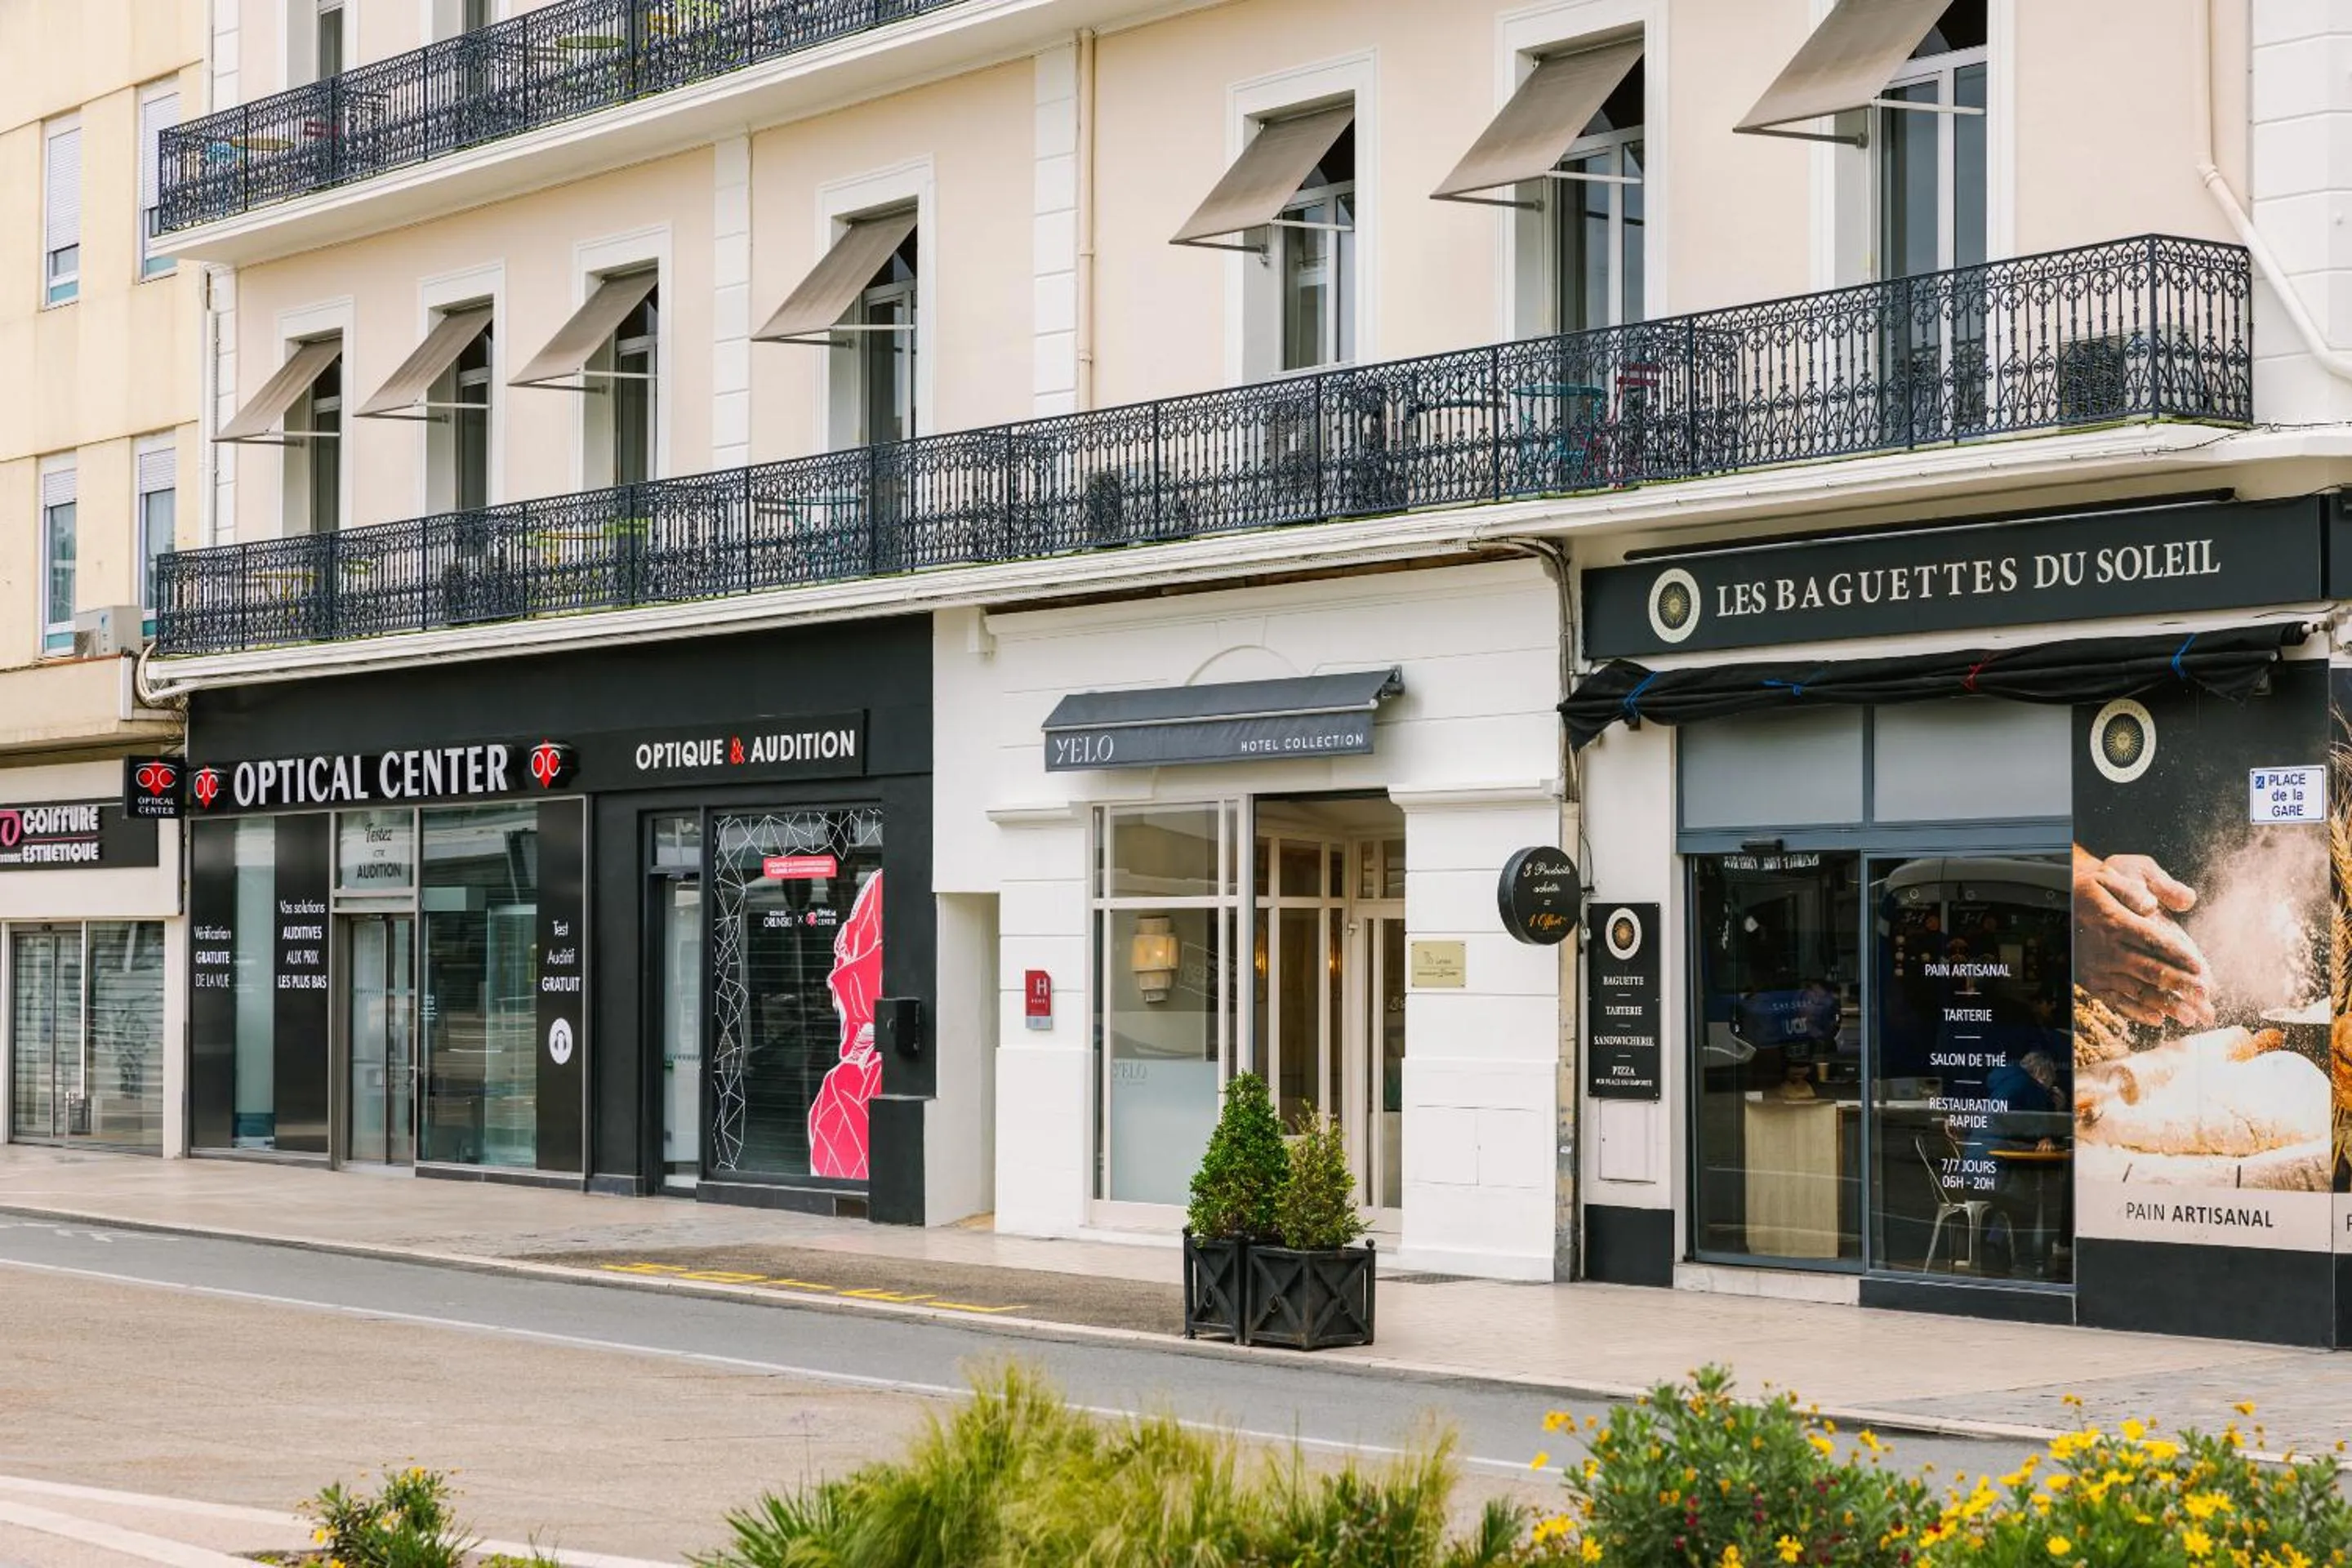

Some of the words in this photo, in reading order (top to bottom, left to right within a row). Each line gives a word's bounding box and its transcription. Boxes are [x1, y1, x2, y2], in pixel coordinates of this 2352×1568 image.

[1717, 581, 1766, 617] LES
[1775, 558, 2018, 611] BAGUETTES
[2034, 551, 2087, 589] DU
[2096, 539, 2221, 584] SOLEIL
[635, 739, 724, 770] OPTIQUE
[729, 735, 746, 764] &
[750, 730, 855, 763] AUDITION
[1055, 734, 1114, 764] YELO
[1241, 738, 1279, 752] HOTEL
[1285, 733, 1364, 751] COLLECTION
[234, 755, 370, 807] OPTICAL
[379, 744, 509, 800] CENTER
[2269, 773, 2305, 786] PLACE
[137, 796, 175, 805] OPTICAL
[2271, 789, 2287, 801] de
[2293, 788, 2303, 801] la
[138, 806, 175, 814] CENTER
[2271, 804, 2304, 817] GARE
[23, 805, 99, 835] COIFFURE
[23, 843, 99, 862] ESTHETIQUE
[357, 862, 402, 879] AUDITION
[280, 900, 292, 913] Vos
[294, 899, 325, 913] solutions
[283, 926, 322, 939] AUDITIVES
[553, 920, 568, 936] Test
[195, 951, 230, 964] GRATUITE
[1925, 963, 1950, 977] PAIN
[1952, 963, 2011, 978] ARTISANAL
[195, 973, 205, 987] DE
[207, 973, 215, 987] LA
[278, 974, 291, 989] LES
[292, 974, 310, 989] PLUS
[312, 974, 327, 989] BAS
[541, 977, 581, 991] GRATUIT
[1036, 978, 1047, 996] H
[1603, 976, 1644, 986] BAGUETTE
[1605, 1005, 1643, 1015] TARTERIE
[1943, 1008, 1993, 1022] TARTERIE
[1593, 1036, 1655, 1047] SANDWICHERIE
[1930, 1053, 1966, 1066] SALON
[1968, 1053, 1983, 1067] DE
[1984, 1051, 2007, 1067] THÉ
[1612, 1065, 1636, 1076] PIZZA
[1929, 1097, 2008, 1112] RESTAURATION
[1949, 1114, 1988, 1129] RAPIDE
[1940, 1158, 1959, 1174] 7/7
[1961, 1160, 1998, 1174] JOURS
[1973, 1177, 1995, 1190] 20H
[2127, 1201, 2165, 1221] PAIN
[2172, 1205, 2274, 1228] ARTISANAL
